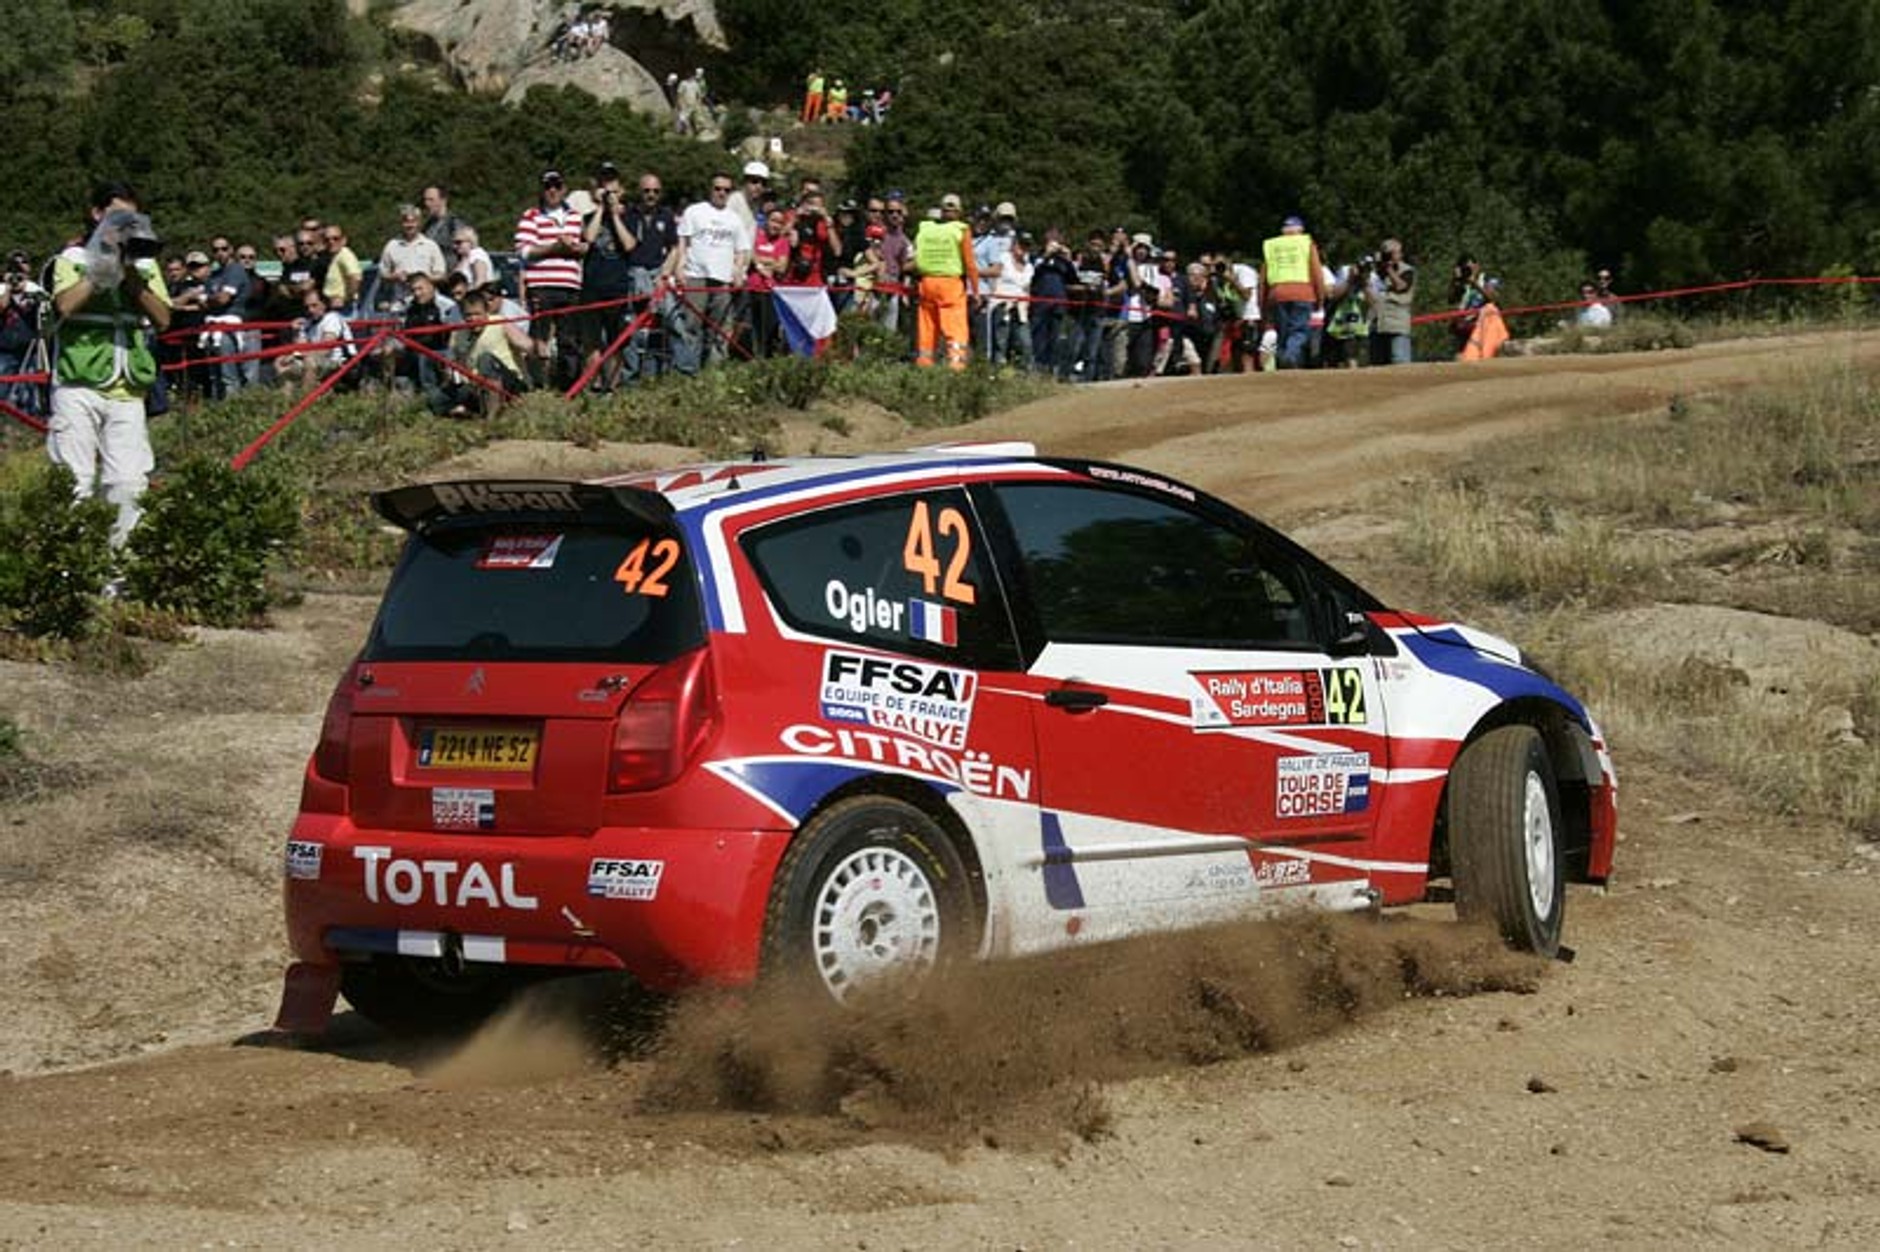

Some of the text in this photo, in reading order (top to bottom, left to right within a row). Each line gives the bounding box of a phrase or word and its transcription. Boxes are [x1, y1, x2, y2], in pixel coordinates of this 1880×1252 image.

[614, 537, 680, 597] 42
[903, 500, 975, 604] 42
[828, 653, 957, 701] FFSA
[1208, 678, 1303, 699] Rally d'Italia
[824, 685, 967, 722] EQUIPE DE FRANCE
[1231, 700, 1306, 720] Sardegna
[1328, 669, 1366, 724] 42
[872, 710, 964, 746] RALLYE
[438, 734, 531, 763] 7214 NE 52
[779, 724, 1031, 799] CITROËN
[1279, 773, 1344, 793] TOUR DE
[1278, 791, 1343, 814] CORSE
[353, 845, 539, 909] TOTAL
[592, 861, 649, 877] FFSA
